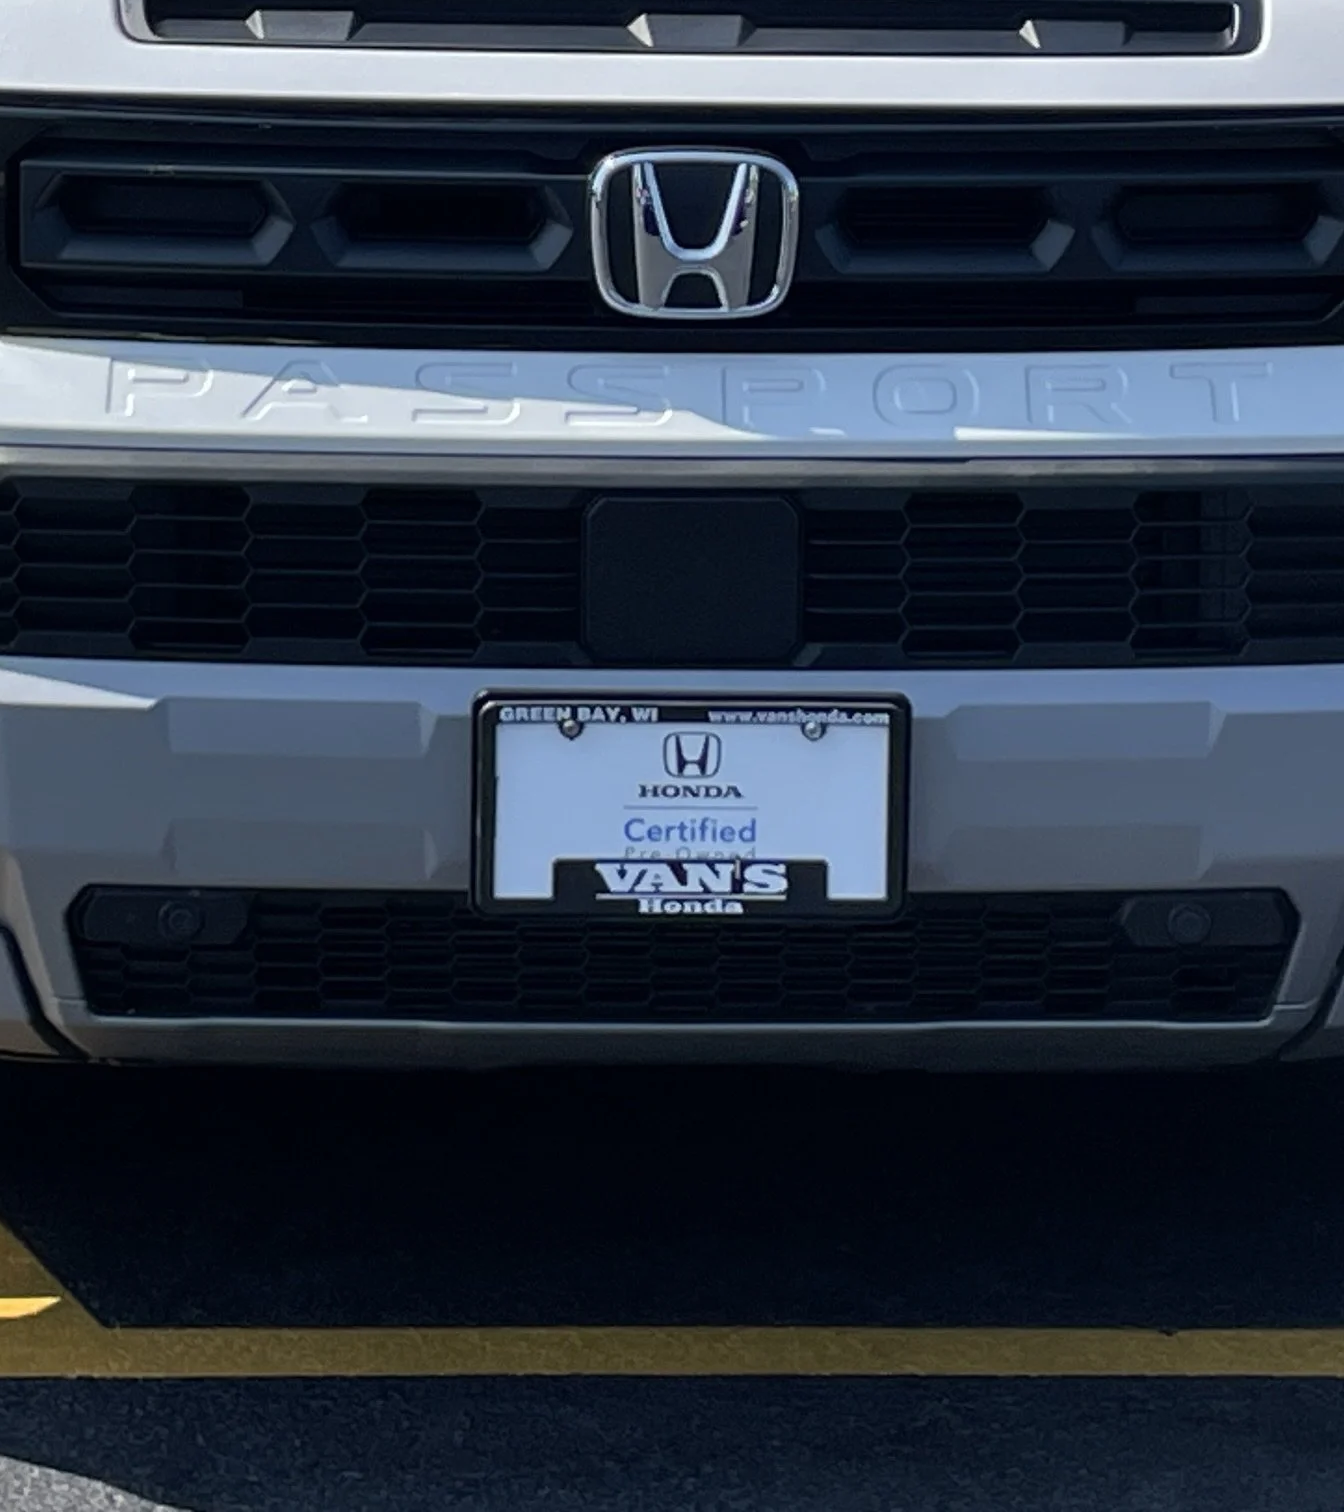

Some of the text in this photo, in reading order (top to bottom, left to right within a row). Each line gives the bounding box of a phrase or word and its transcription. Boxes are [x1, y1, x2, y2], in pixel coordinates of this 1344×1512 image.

[104, 355, 1274, 427] PASSPORT
[499, 706, 659, 724] GREEN BAY, WI
[707, 707, 890, 724] www.vanshonda.com
[637, 784, 745, 799] HONDA
[623, 817, 757, 843] Certified
[594, 859, 789, 893] VAN'S
[637, 898, 745, 914] Honda
